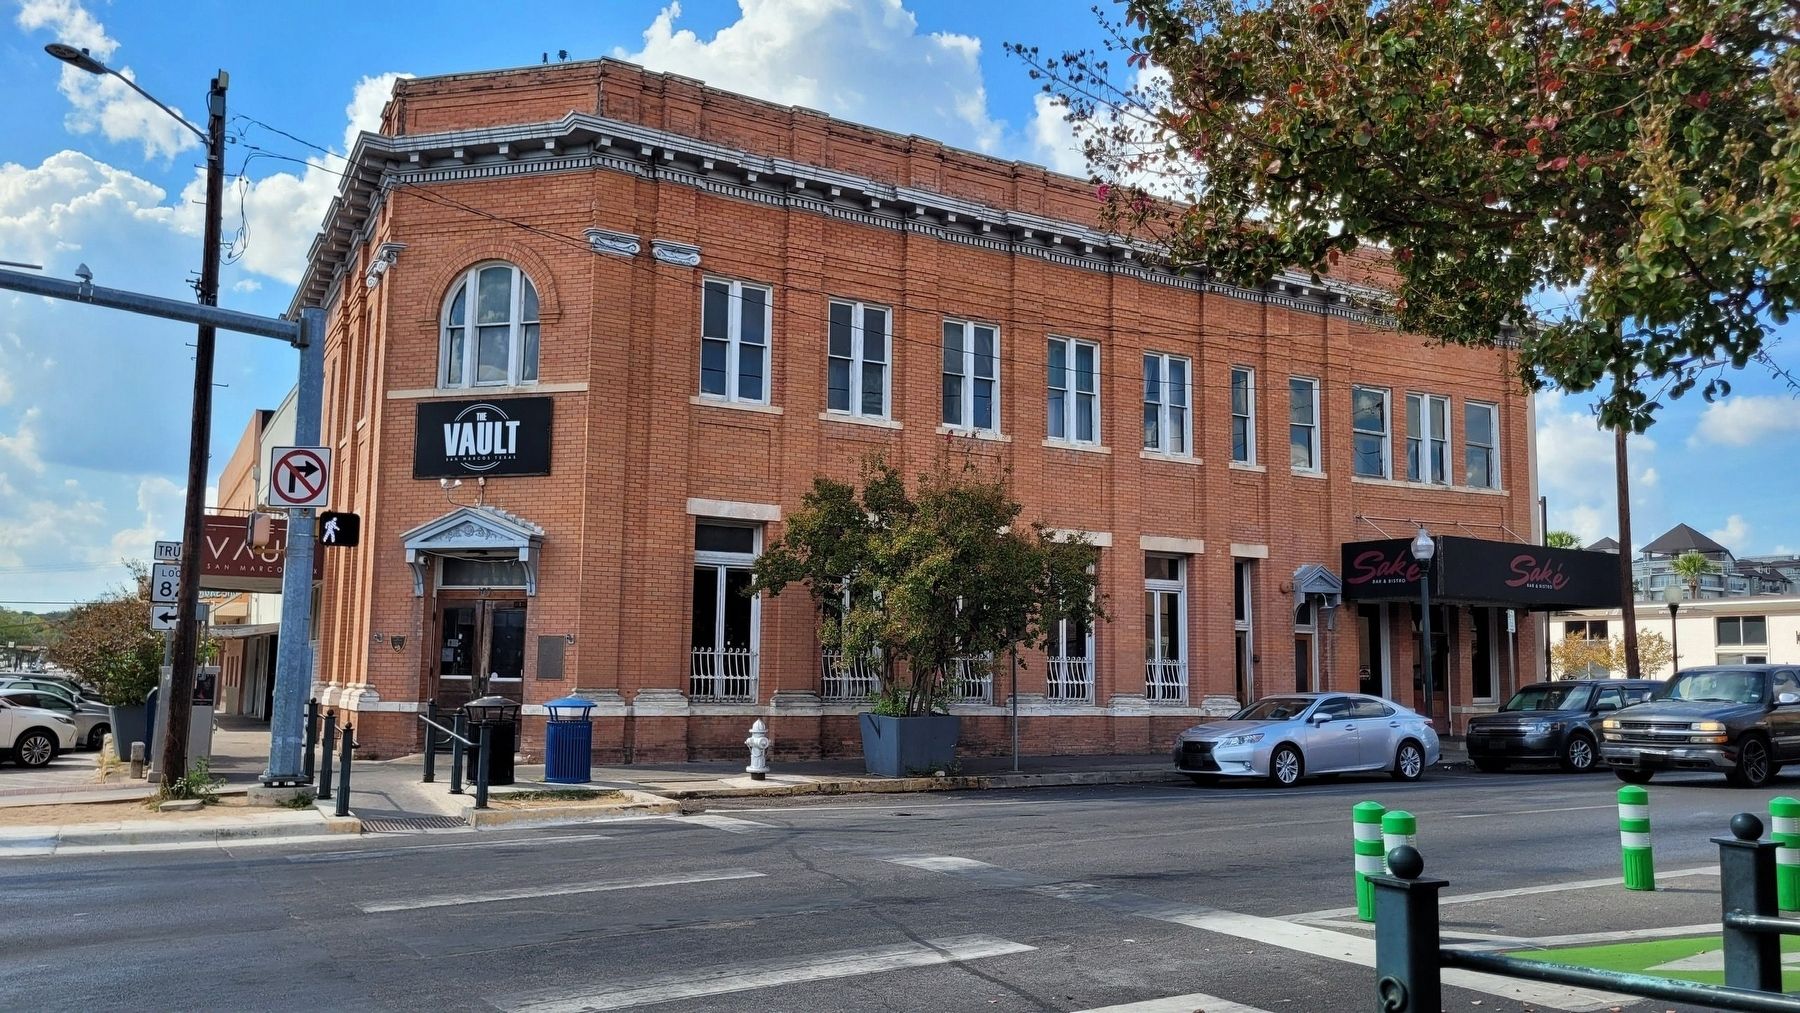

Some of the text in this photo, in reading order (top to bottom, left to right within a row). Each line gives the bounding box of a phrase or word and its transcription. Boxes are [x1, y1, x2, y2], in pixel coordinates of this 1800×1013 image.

[476, 412, 487, 421] THE
[443, 421, 520, 456] VAULT
[158, 545, 181, 557] TRU
[206, 535, 280, 563] VAU
[161, 569, 182, 578] LOO
[240, 565, 283, 573] MARCO
